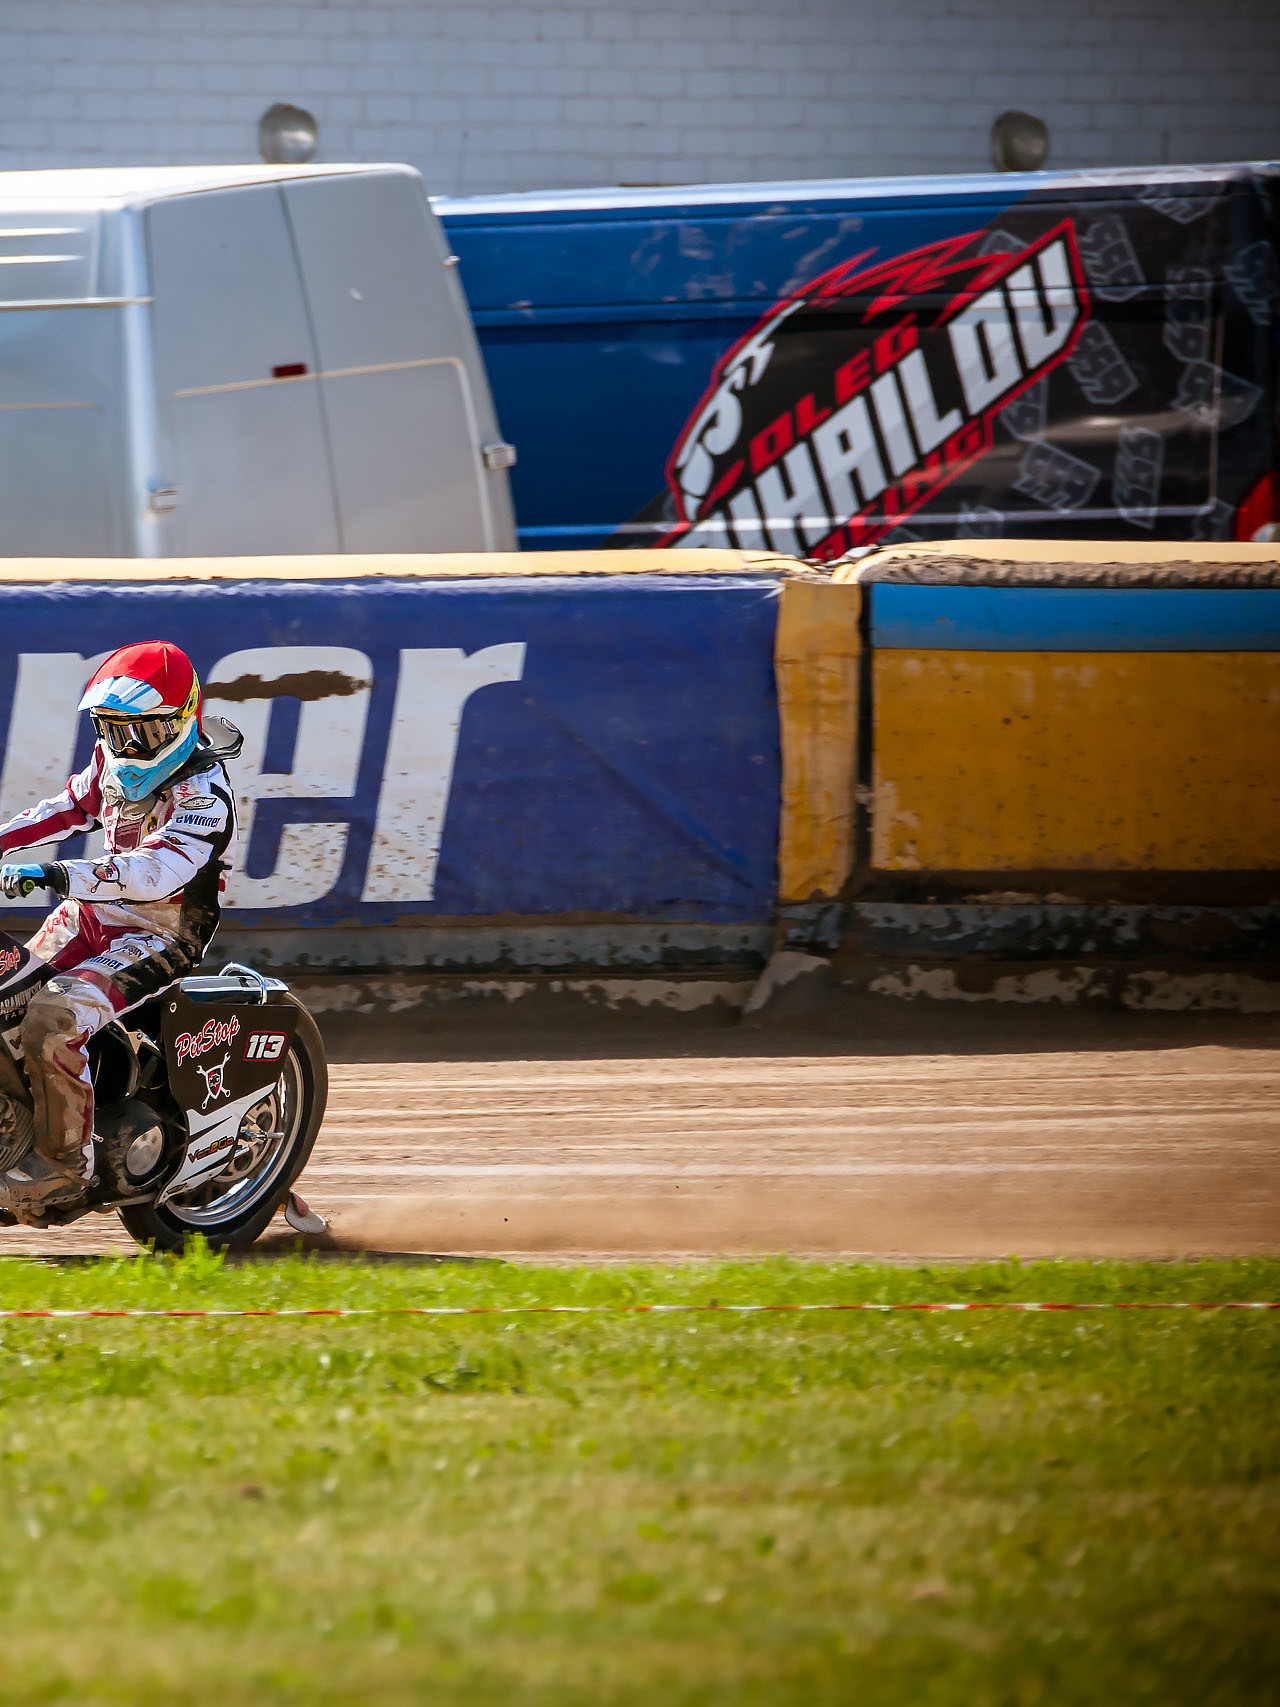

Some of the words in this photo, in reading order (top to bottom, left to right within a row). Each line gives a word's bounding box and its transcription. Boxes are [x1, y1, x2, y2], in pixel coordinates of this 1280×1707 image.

[749, 314, 918, 475] OLEG
[810, 418, 982, 562] ACING
[175, 1015, 240, 1067] PitStop
[246, 1034, 285, 1059] 113
